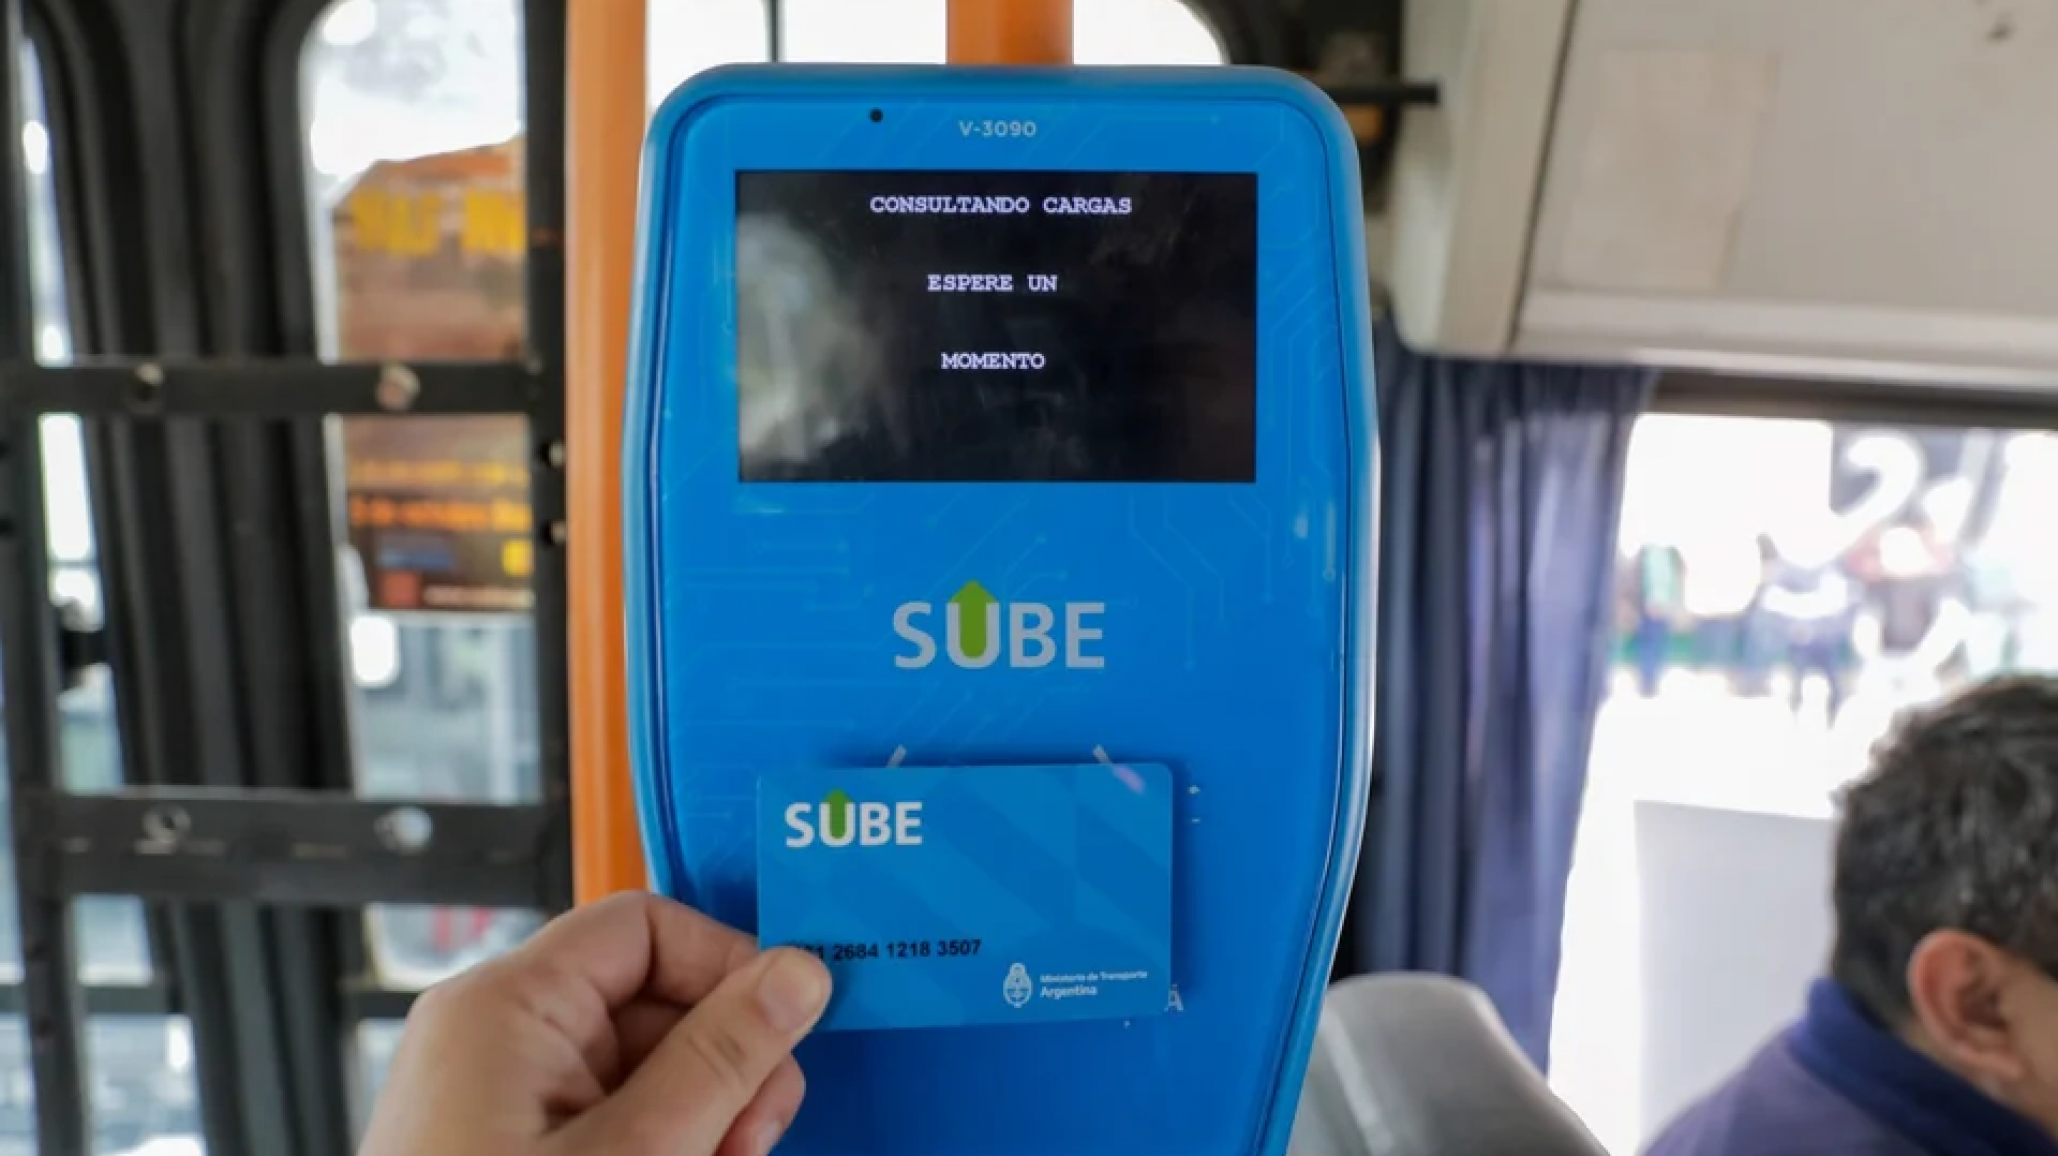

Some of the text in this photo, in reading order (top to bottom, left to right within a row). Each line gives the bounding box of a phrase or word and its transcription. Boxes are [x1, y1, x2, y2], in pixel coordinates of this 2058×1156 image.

[960, 121, 1037, 136] V-3090
[870, 196, 1133, 214] CONSULTANDO CARGAS
[927, 274, 1058, 291] ESPERE UN
[940, 353, 1046, 370] MOMENTO
[893, 601, 1105, 668] SUBE
[785, 801, 923, 848] SUBE
[833, 942, 879, 961] 2684
[886, 940, 932, 959] 1218
[937, 938, 982, 957] 3507
[1040, 985, 1098, 1000] Argentina
